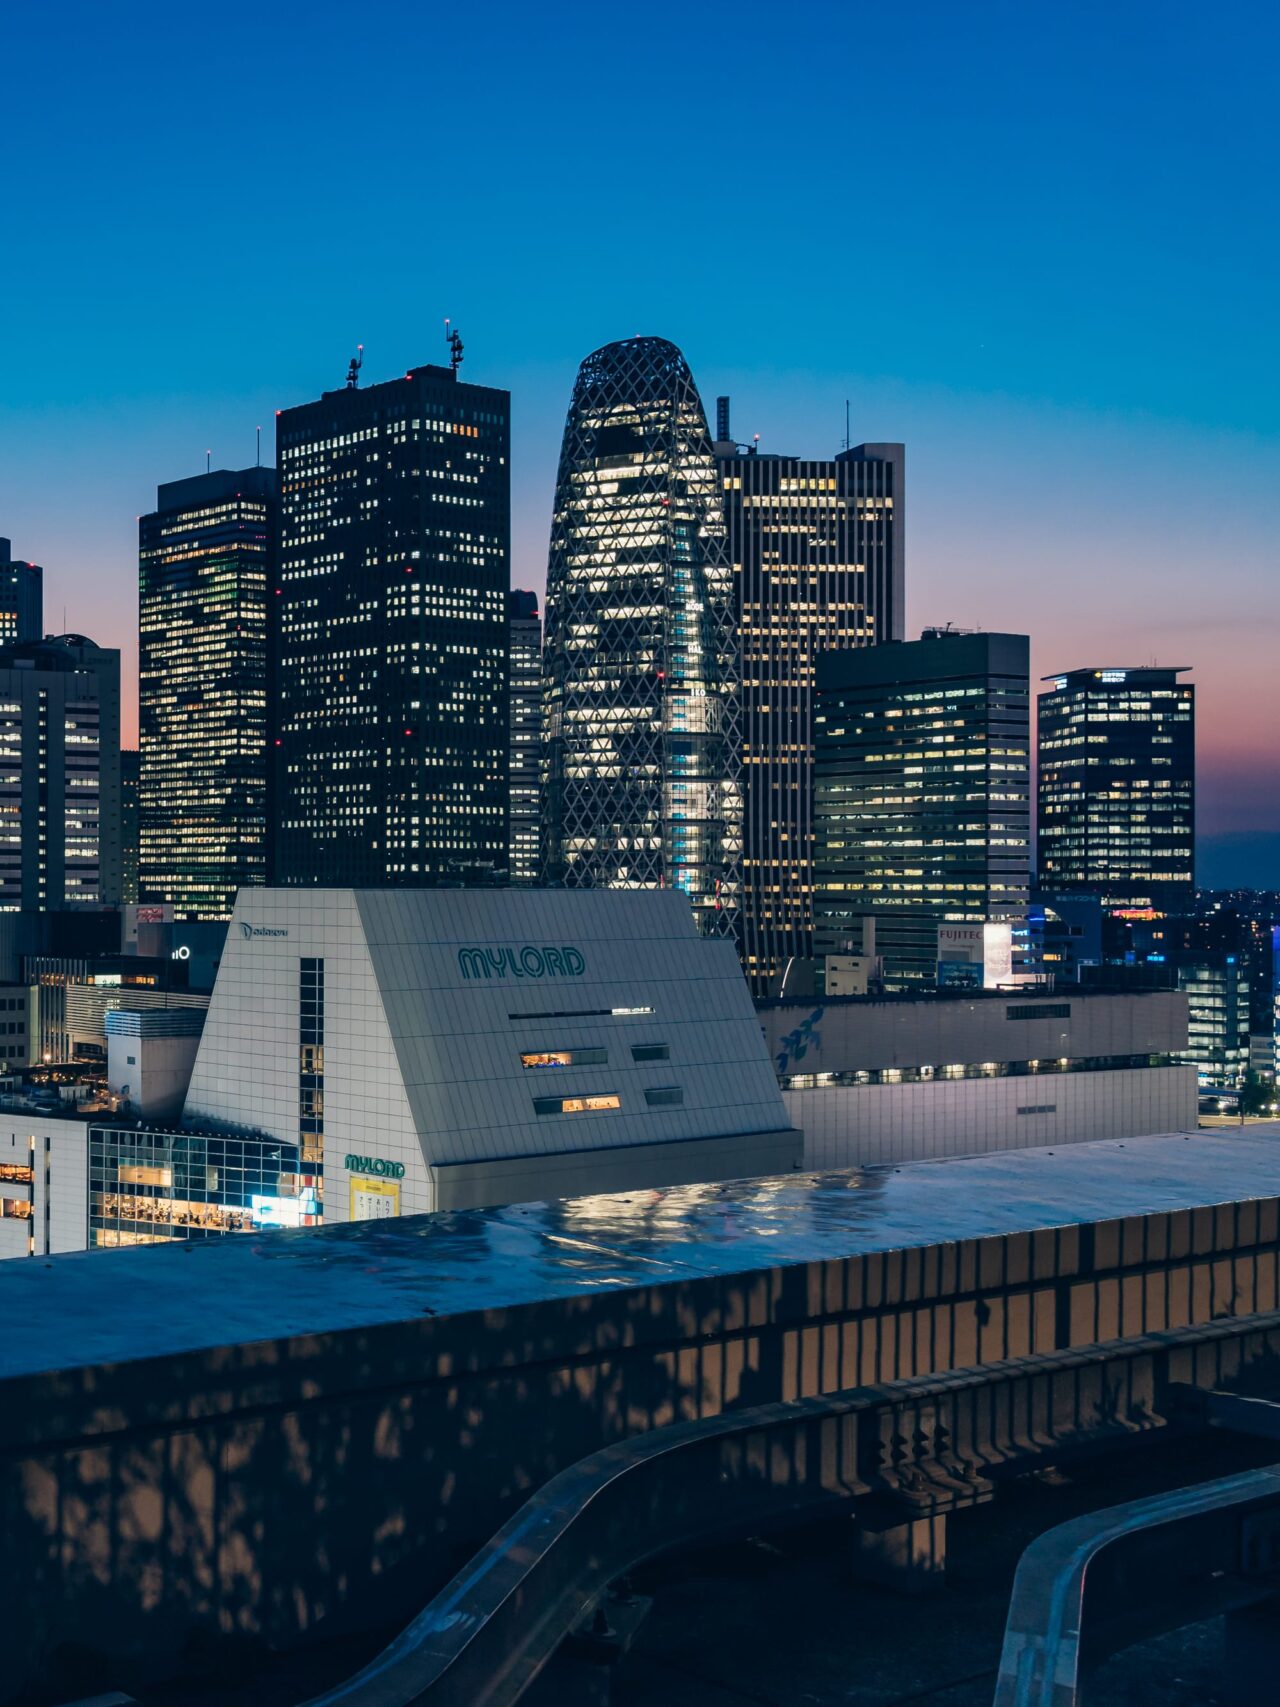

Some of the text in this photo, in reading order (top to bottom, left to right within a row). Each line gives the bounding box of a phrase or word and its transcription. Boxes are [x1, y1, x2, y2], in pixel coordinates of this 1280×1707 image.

[940, 930, 983, 941] FUJITEC
[458, 946, 586, 979] MYLORD
[345, 1154, 405, 1180] MYLORD
